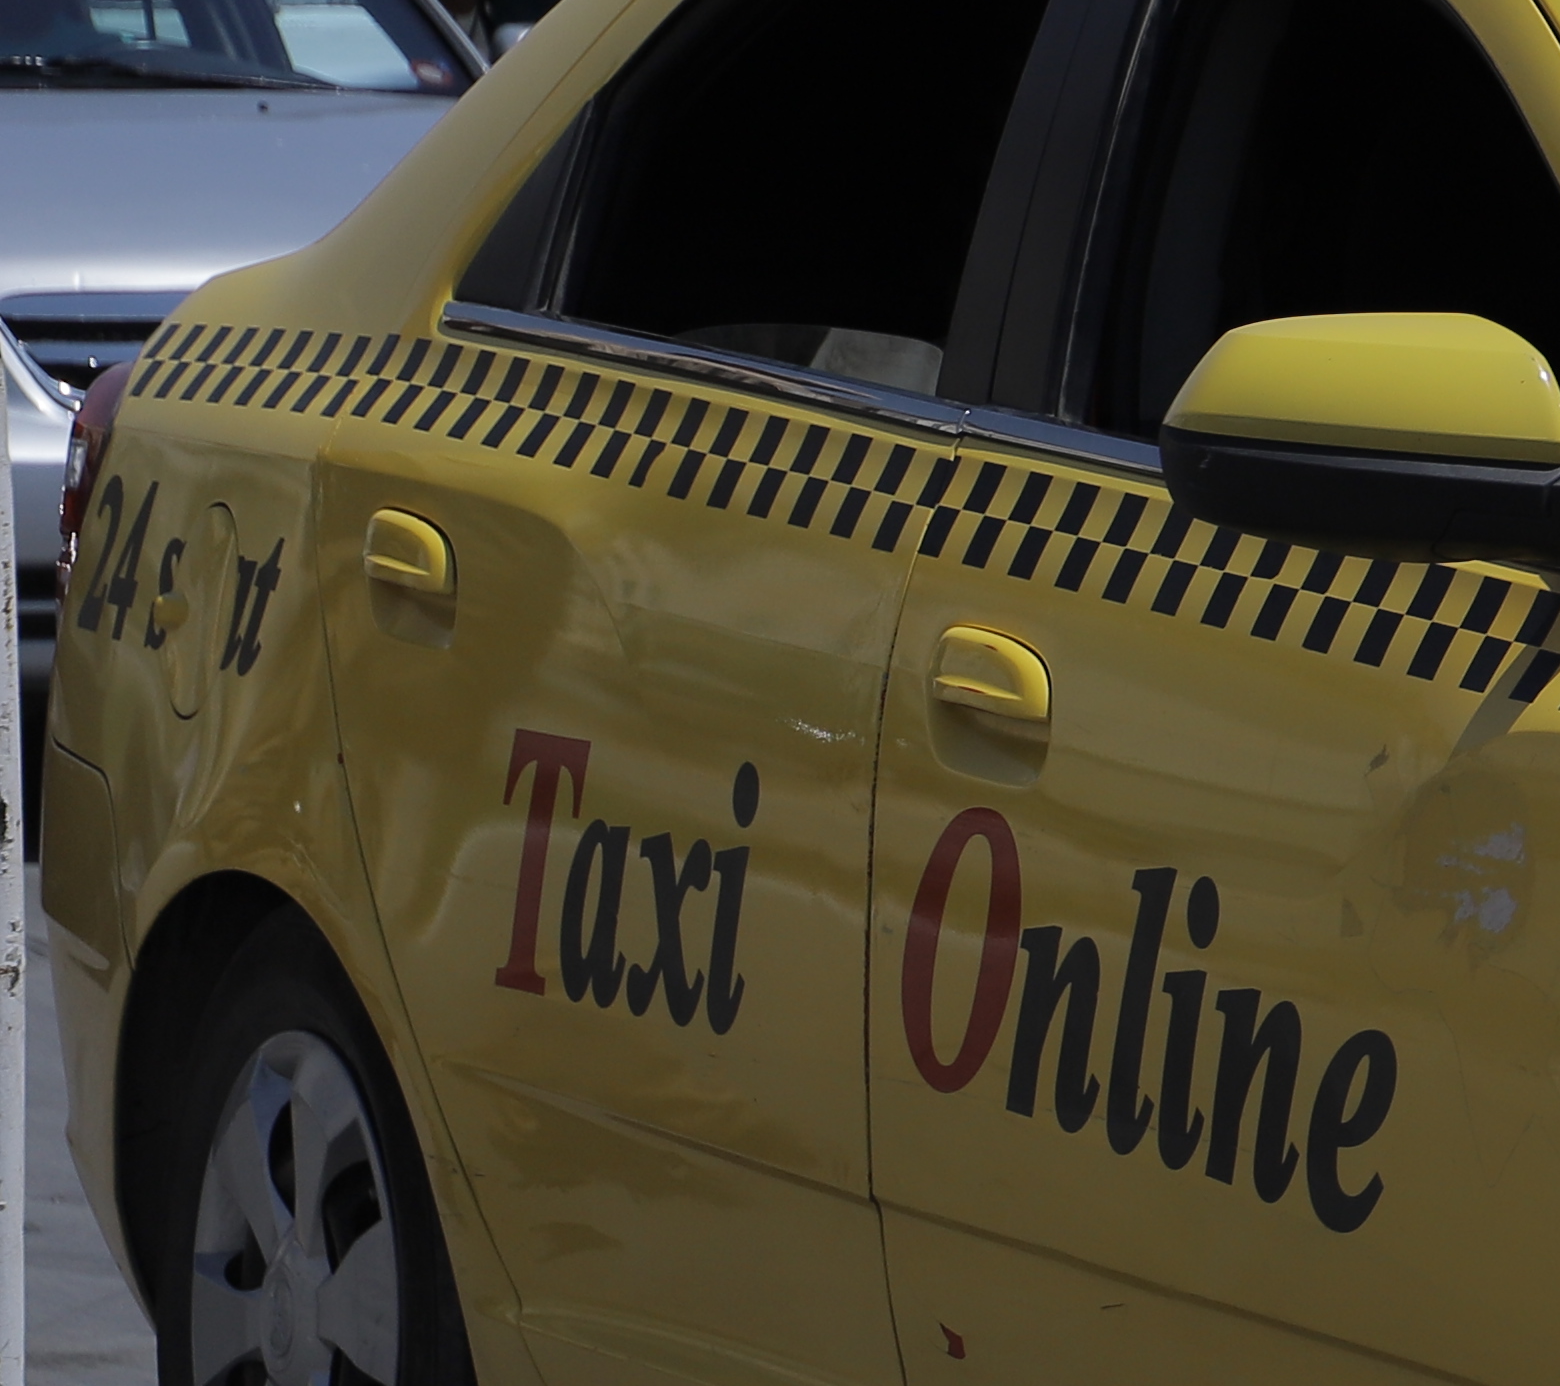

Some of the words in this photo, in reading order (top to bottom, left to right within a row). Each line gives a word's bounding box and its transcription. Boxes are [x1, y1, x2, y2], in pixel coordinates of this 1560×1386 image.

[77, 474, 159, 640] 24
[494, 727, 760, 1035] Taxi
[901, 806, 1398, 1233] Online
